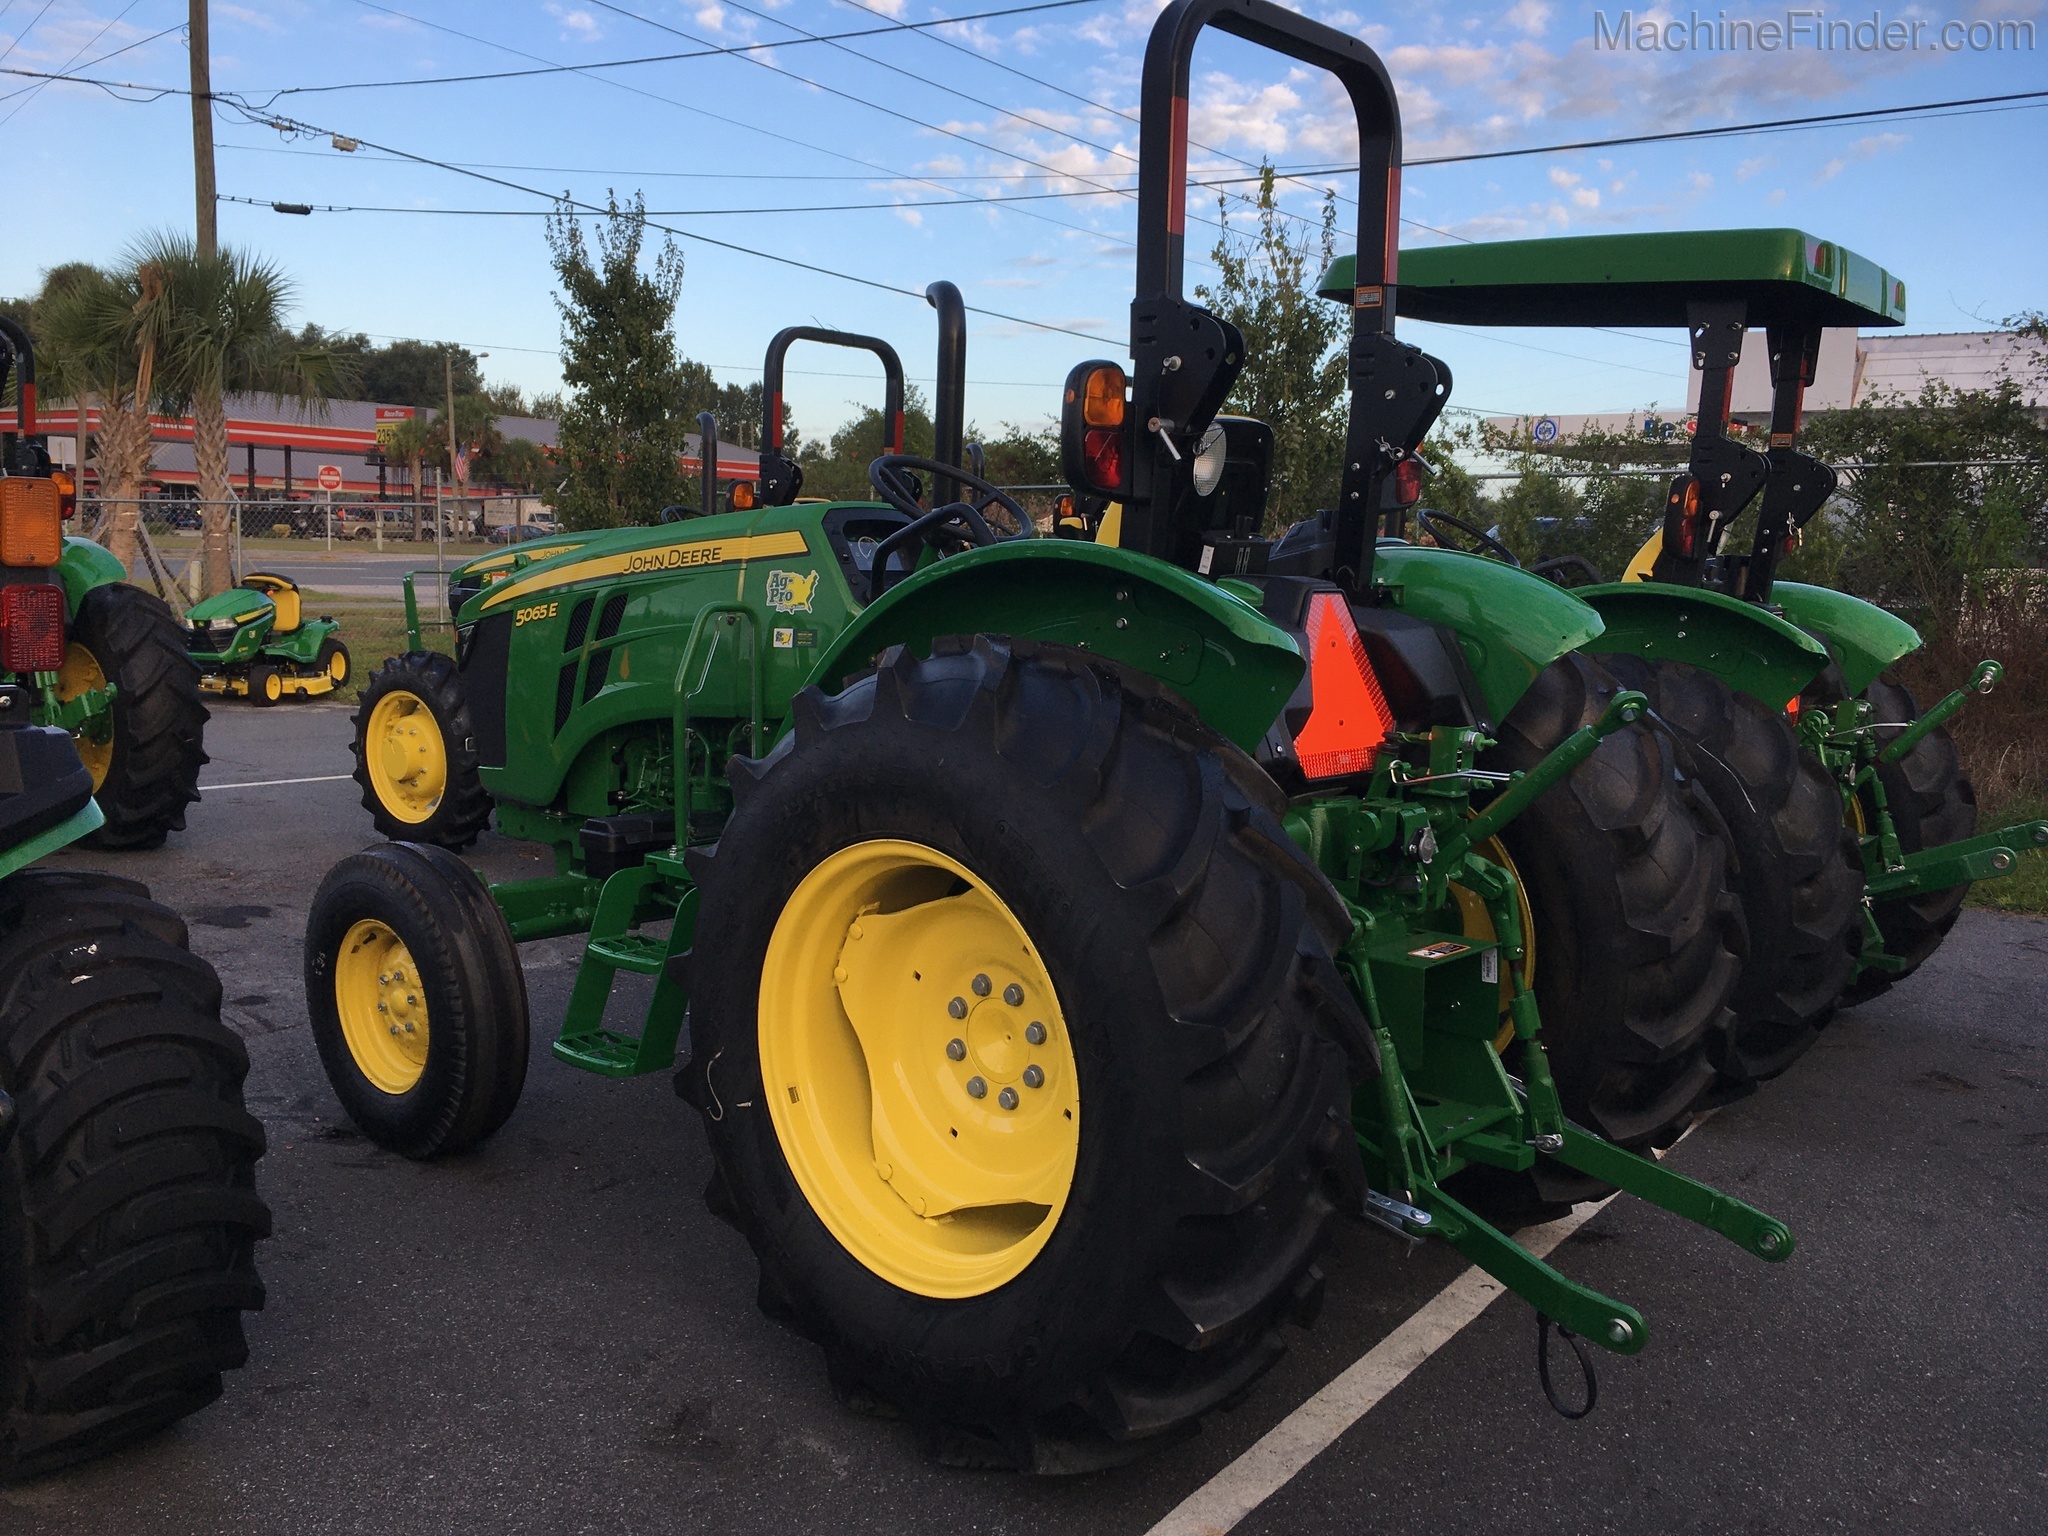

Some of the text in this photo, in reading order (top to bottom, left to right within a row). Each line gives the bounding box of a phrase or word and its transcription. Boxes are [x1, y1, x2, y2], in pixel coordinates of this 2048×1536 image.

[623, 547, 722, 572] JOHN DEERE
[769, 588, 793, 603] Pro
[515, 602, 559, 627] 5065 E
